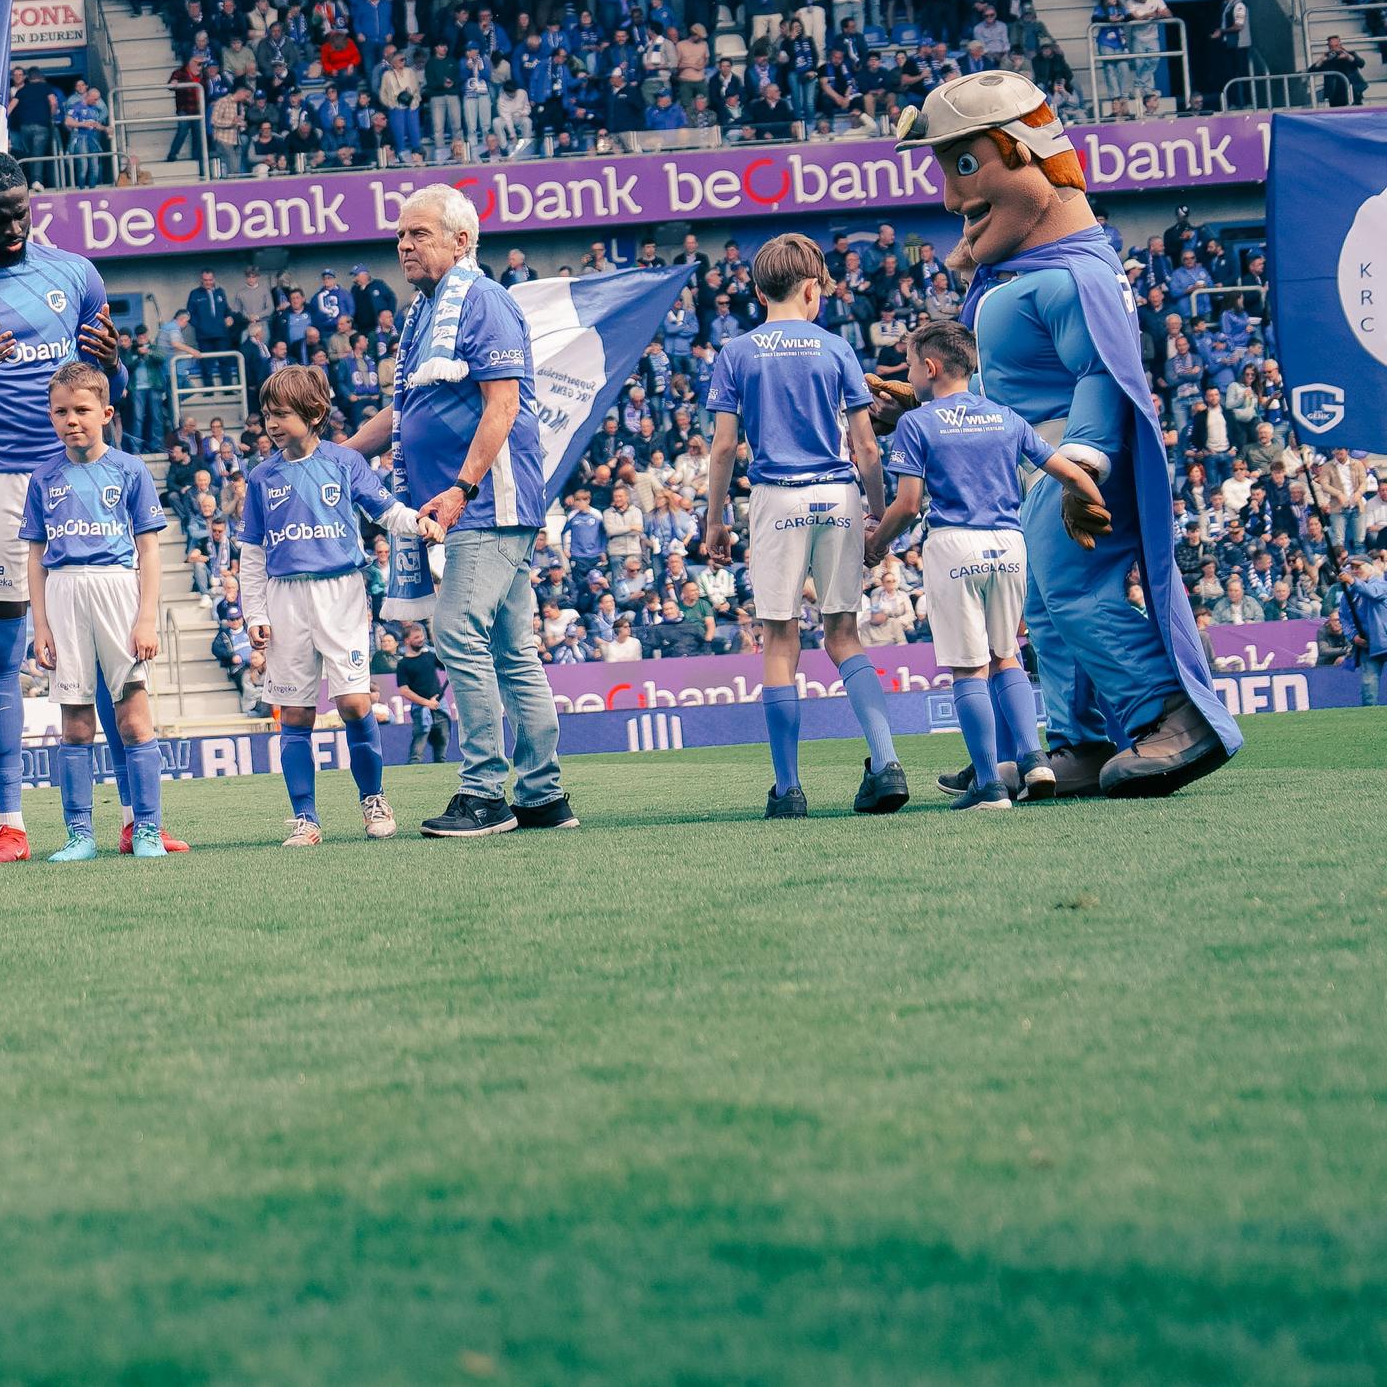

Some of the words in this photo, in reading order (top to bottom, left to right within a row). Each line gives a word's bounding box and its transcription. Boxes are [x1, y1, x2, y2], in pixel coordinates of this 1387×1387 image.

[11, 5, 83, 27] CONA
[1083, 126, 1237, 184] bank
[612, 238, 628, 263] L
[781, 338, 821, 350] WILMS
[966, 414, 1004, 426] WILMS
[774, 516, 852, 531] CARGLASS
[949, 562, 1021, 580] CARGLASS
